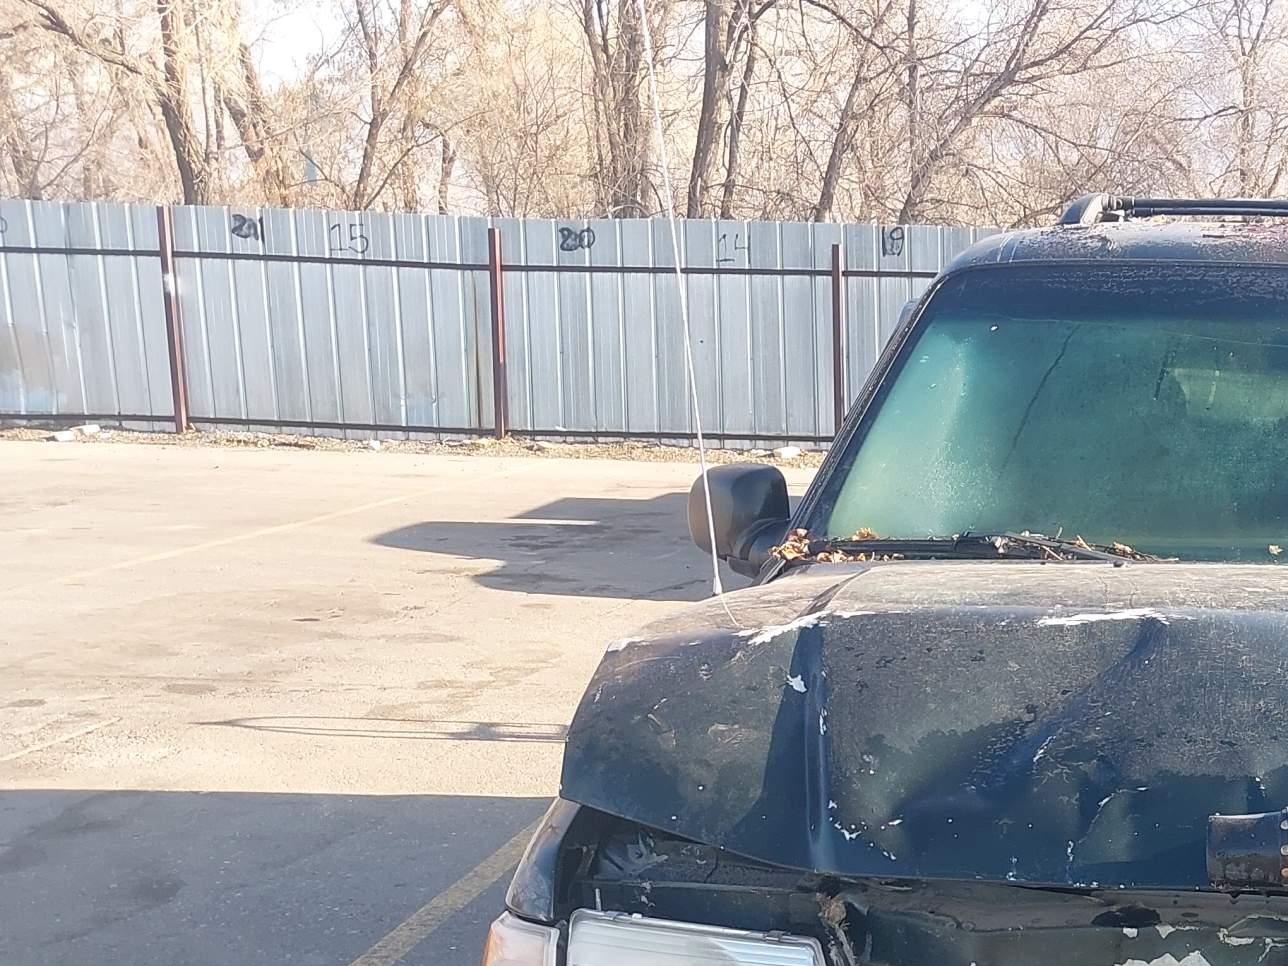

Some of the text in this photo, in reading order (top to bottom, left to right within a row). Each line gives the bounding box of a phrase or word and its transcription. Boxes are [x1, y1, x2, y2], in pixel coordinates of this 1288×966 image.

[330, 223, 369, 254] 15
[559, 227, 595, 251] 20
[715, 233, 751, 265] 14
